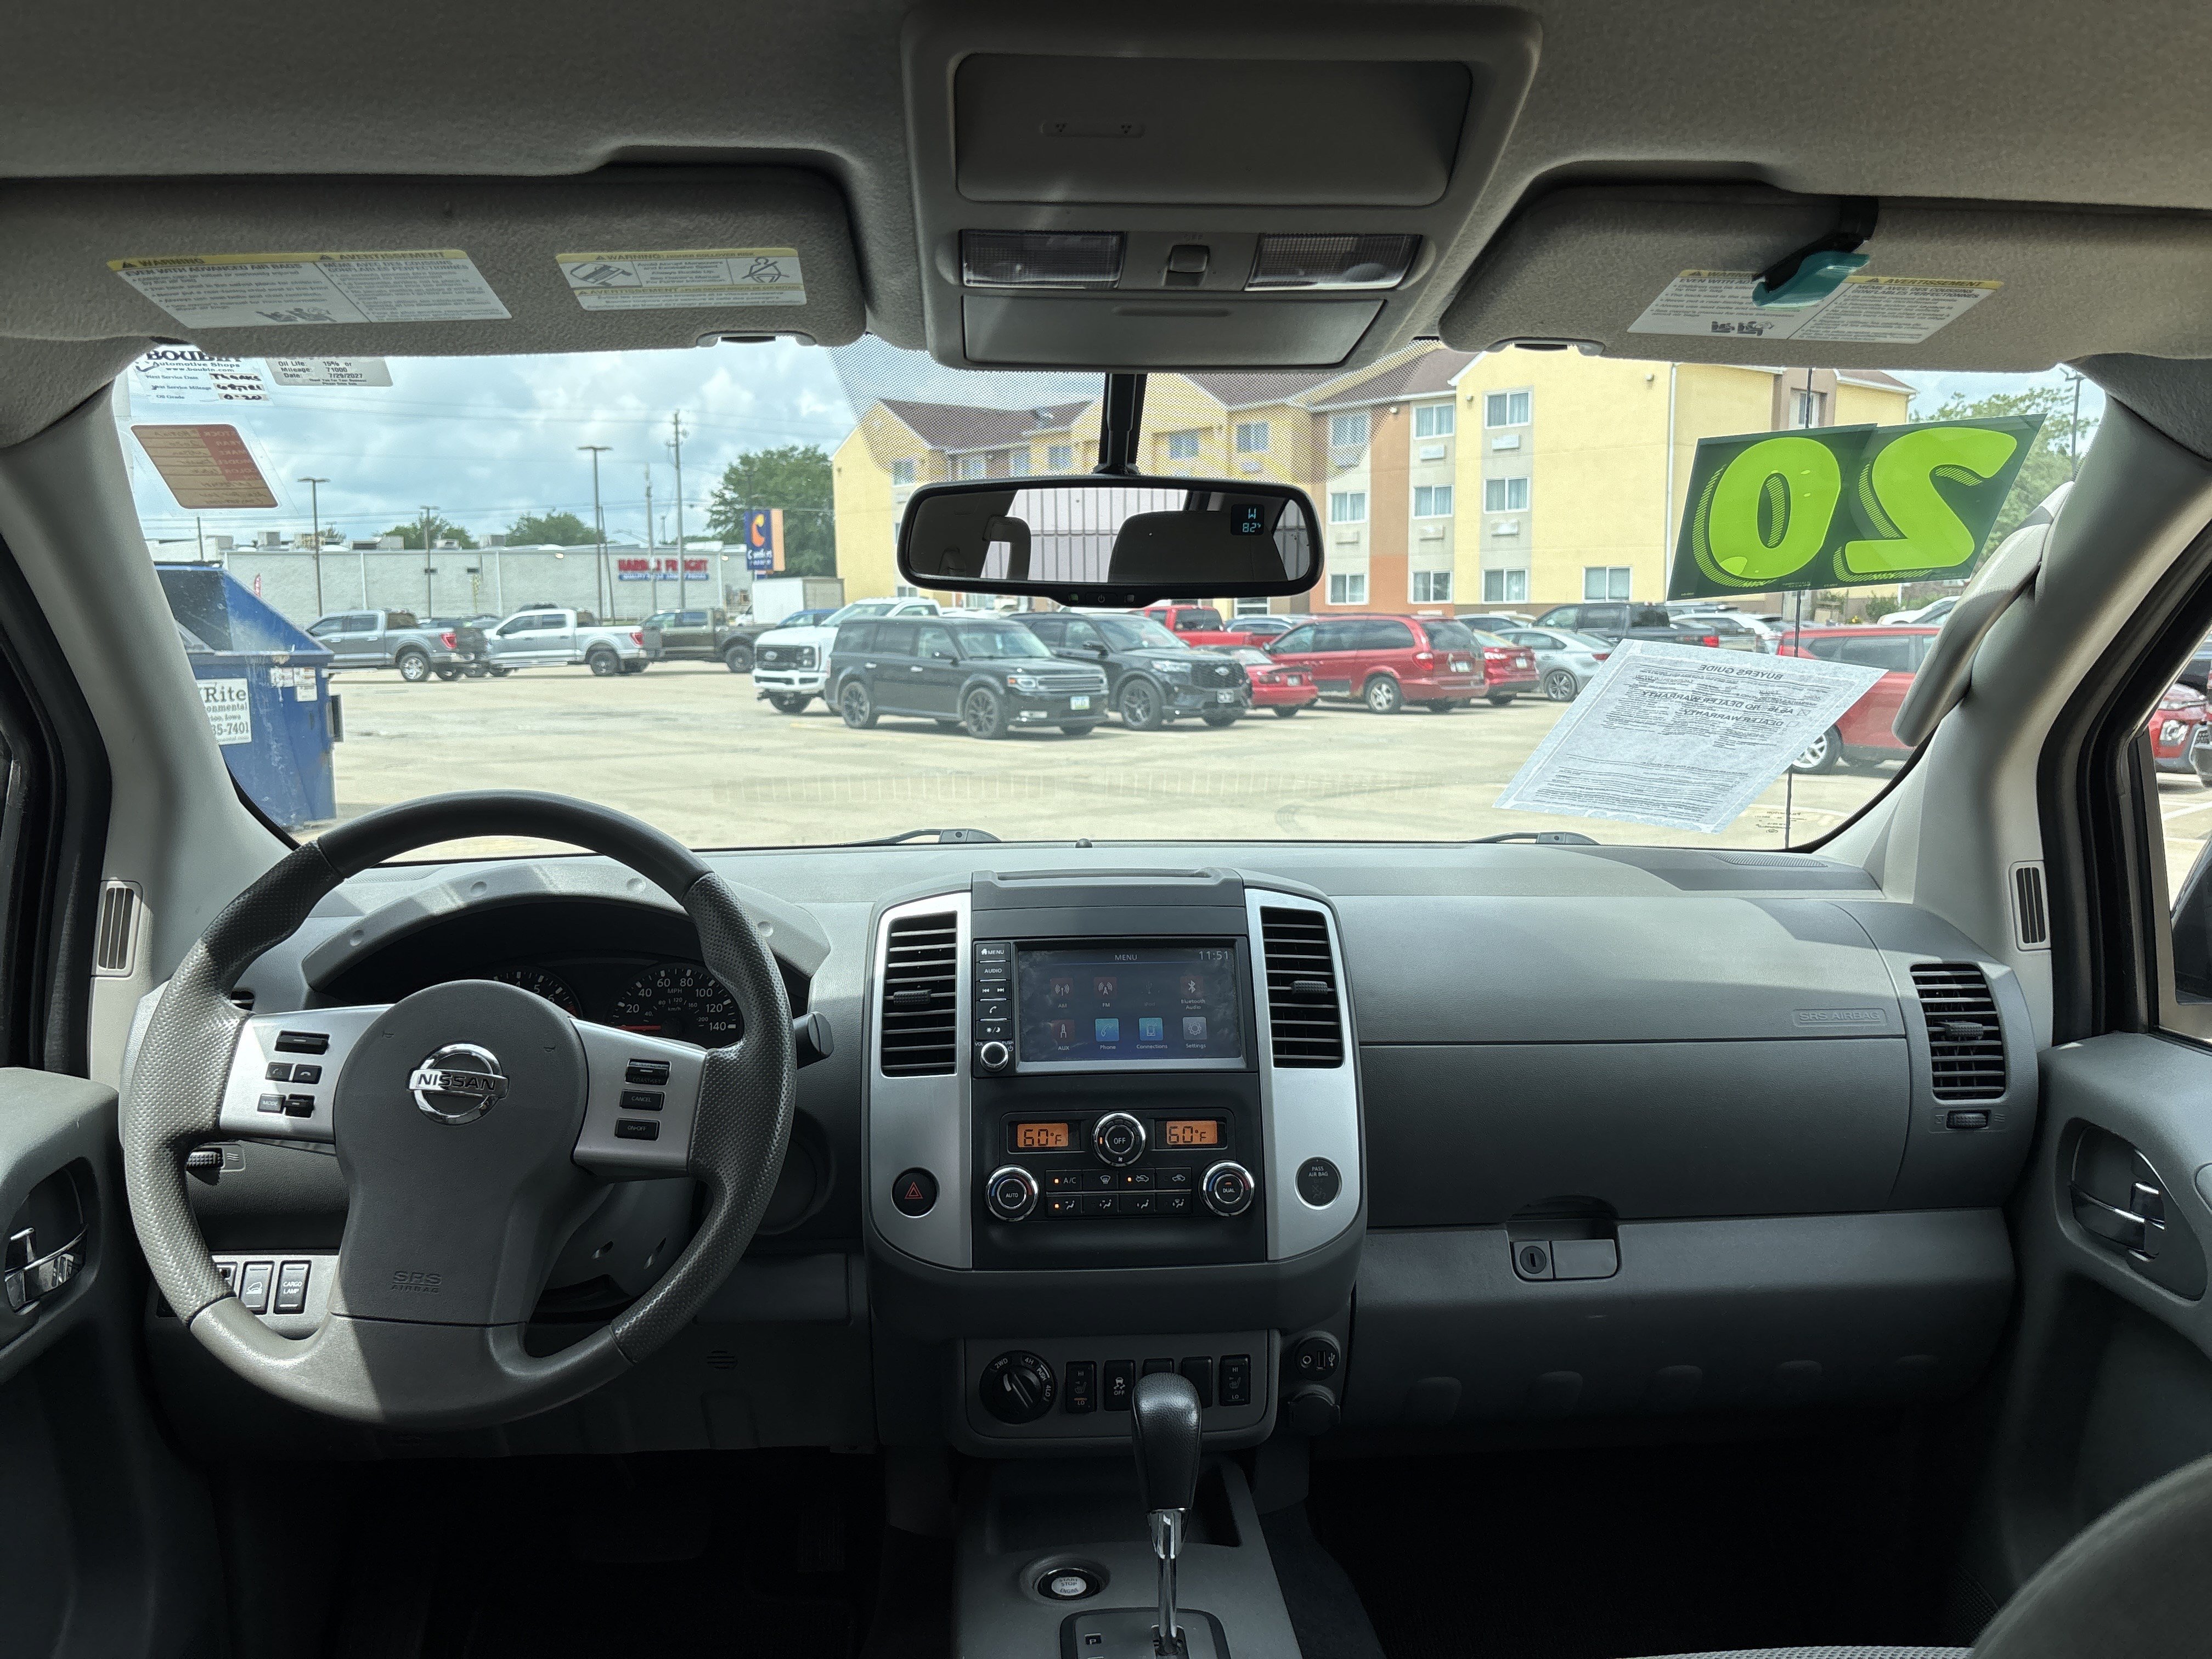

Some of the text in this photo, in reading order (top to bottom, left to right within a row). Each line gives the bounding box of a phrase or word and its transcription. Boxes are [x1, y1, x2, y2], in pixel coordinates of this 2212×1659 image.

[139, 257, 205, 266] WARNING
[1884, 278, 1982, 287] AVERTISSEMENT
[146, 349, 241, 362] BOUB
[1248, 508, 1257, 520] W
[618, 559, 707, 572] HARBR FRIGHT
[199, 685, 246, 703] Rite
[206, 702, 247, 713] onmental
[1199, 951, 1229, 960] 11:51
[657, 978, 670, 987] 60
[680, 978, 693, 987] 80
[534, 985, 540, 994] 5
[638, 989, 652, 997] 40
[696, 989, 713, 997] 100
[626, 1004, 640, 1013] 20
[706, 1003, 723, 1013] 120
[1831, 1012, 1880, 1020] AIRBAG
[709, 1022, 726, 1031] 140
[418, 1074, 495, 1090] NISSAN
[1023, 1129, 1062, 1147] 60°F
[1168, 1126, 1206, 1144] 60°F
[394, 1271, 442, 1284] SRS
[391, 1285, 439, 1293] AIRBAG
[995, 1358, 1008, 1369] 2WD
[1024, 1357, 1034, 1365] 4H
[1036, 1368, 1047, 1381] PUSH
